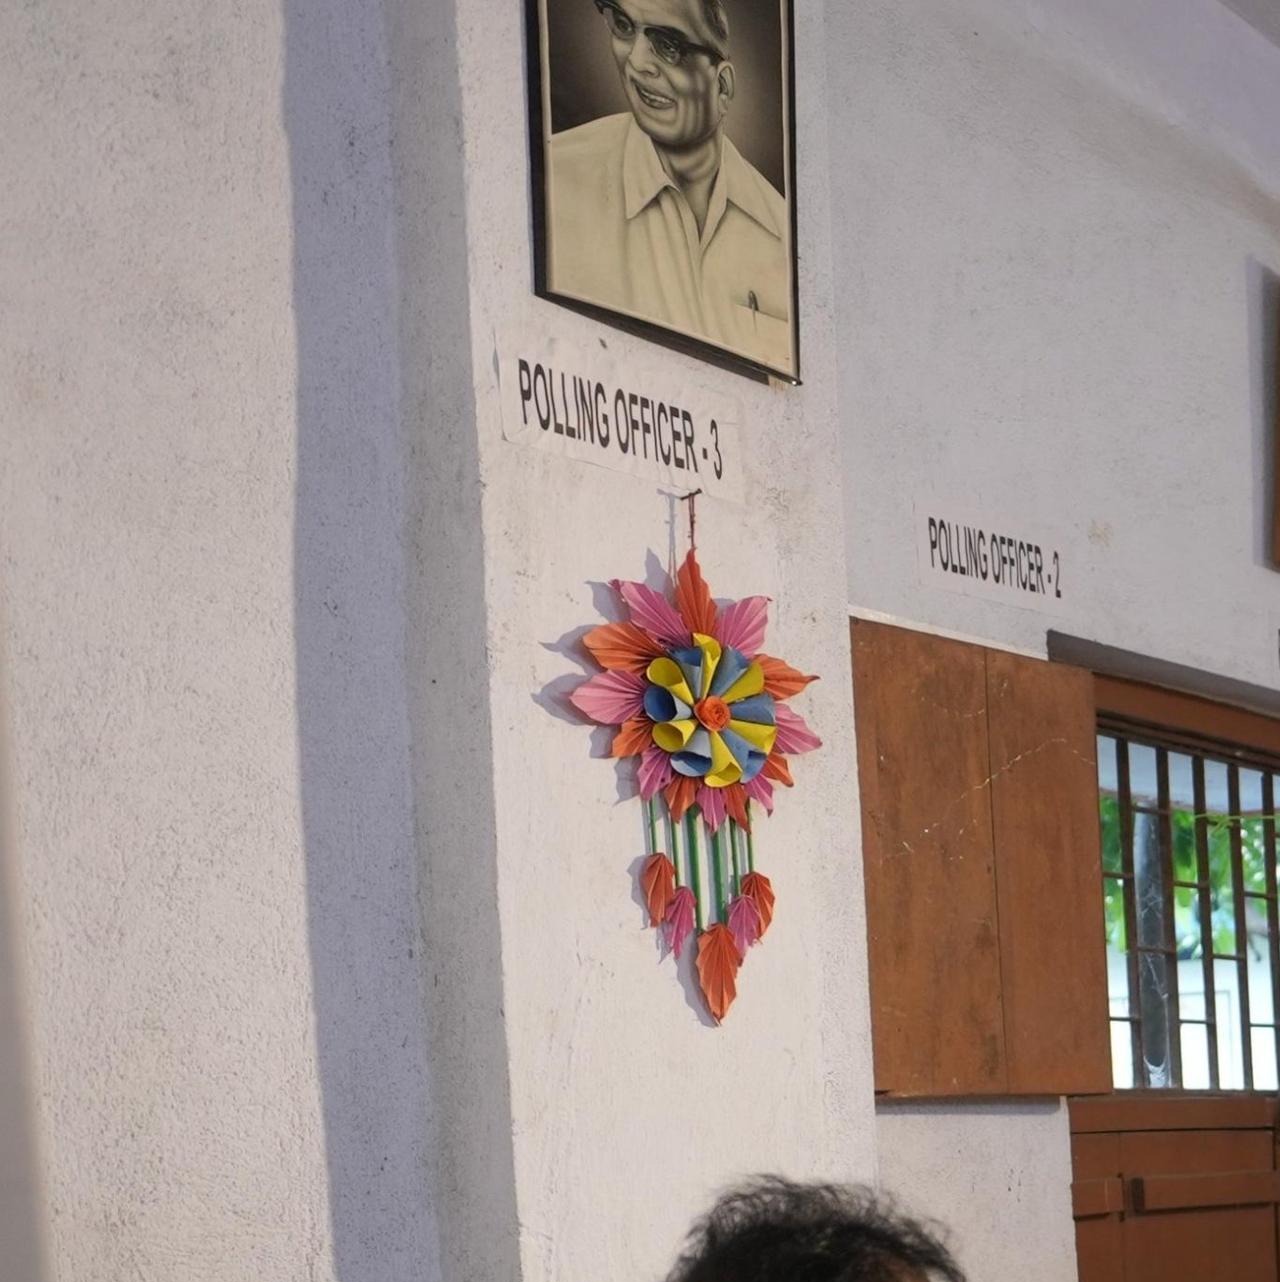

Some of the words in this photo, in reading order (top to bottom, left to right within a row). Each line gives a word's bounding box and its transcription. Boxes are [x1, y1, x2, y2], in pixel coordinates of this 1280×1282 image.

[518, 358, 610, 449] POLLING
[614, 388, 699, 473] OFFICER
[928, 516, 988, 582] POLLING
[990, 533, 1046, 595] OFFICER
